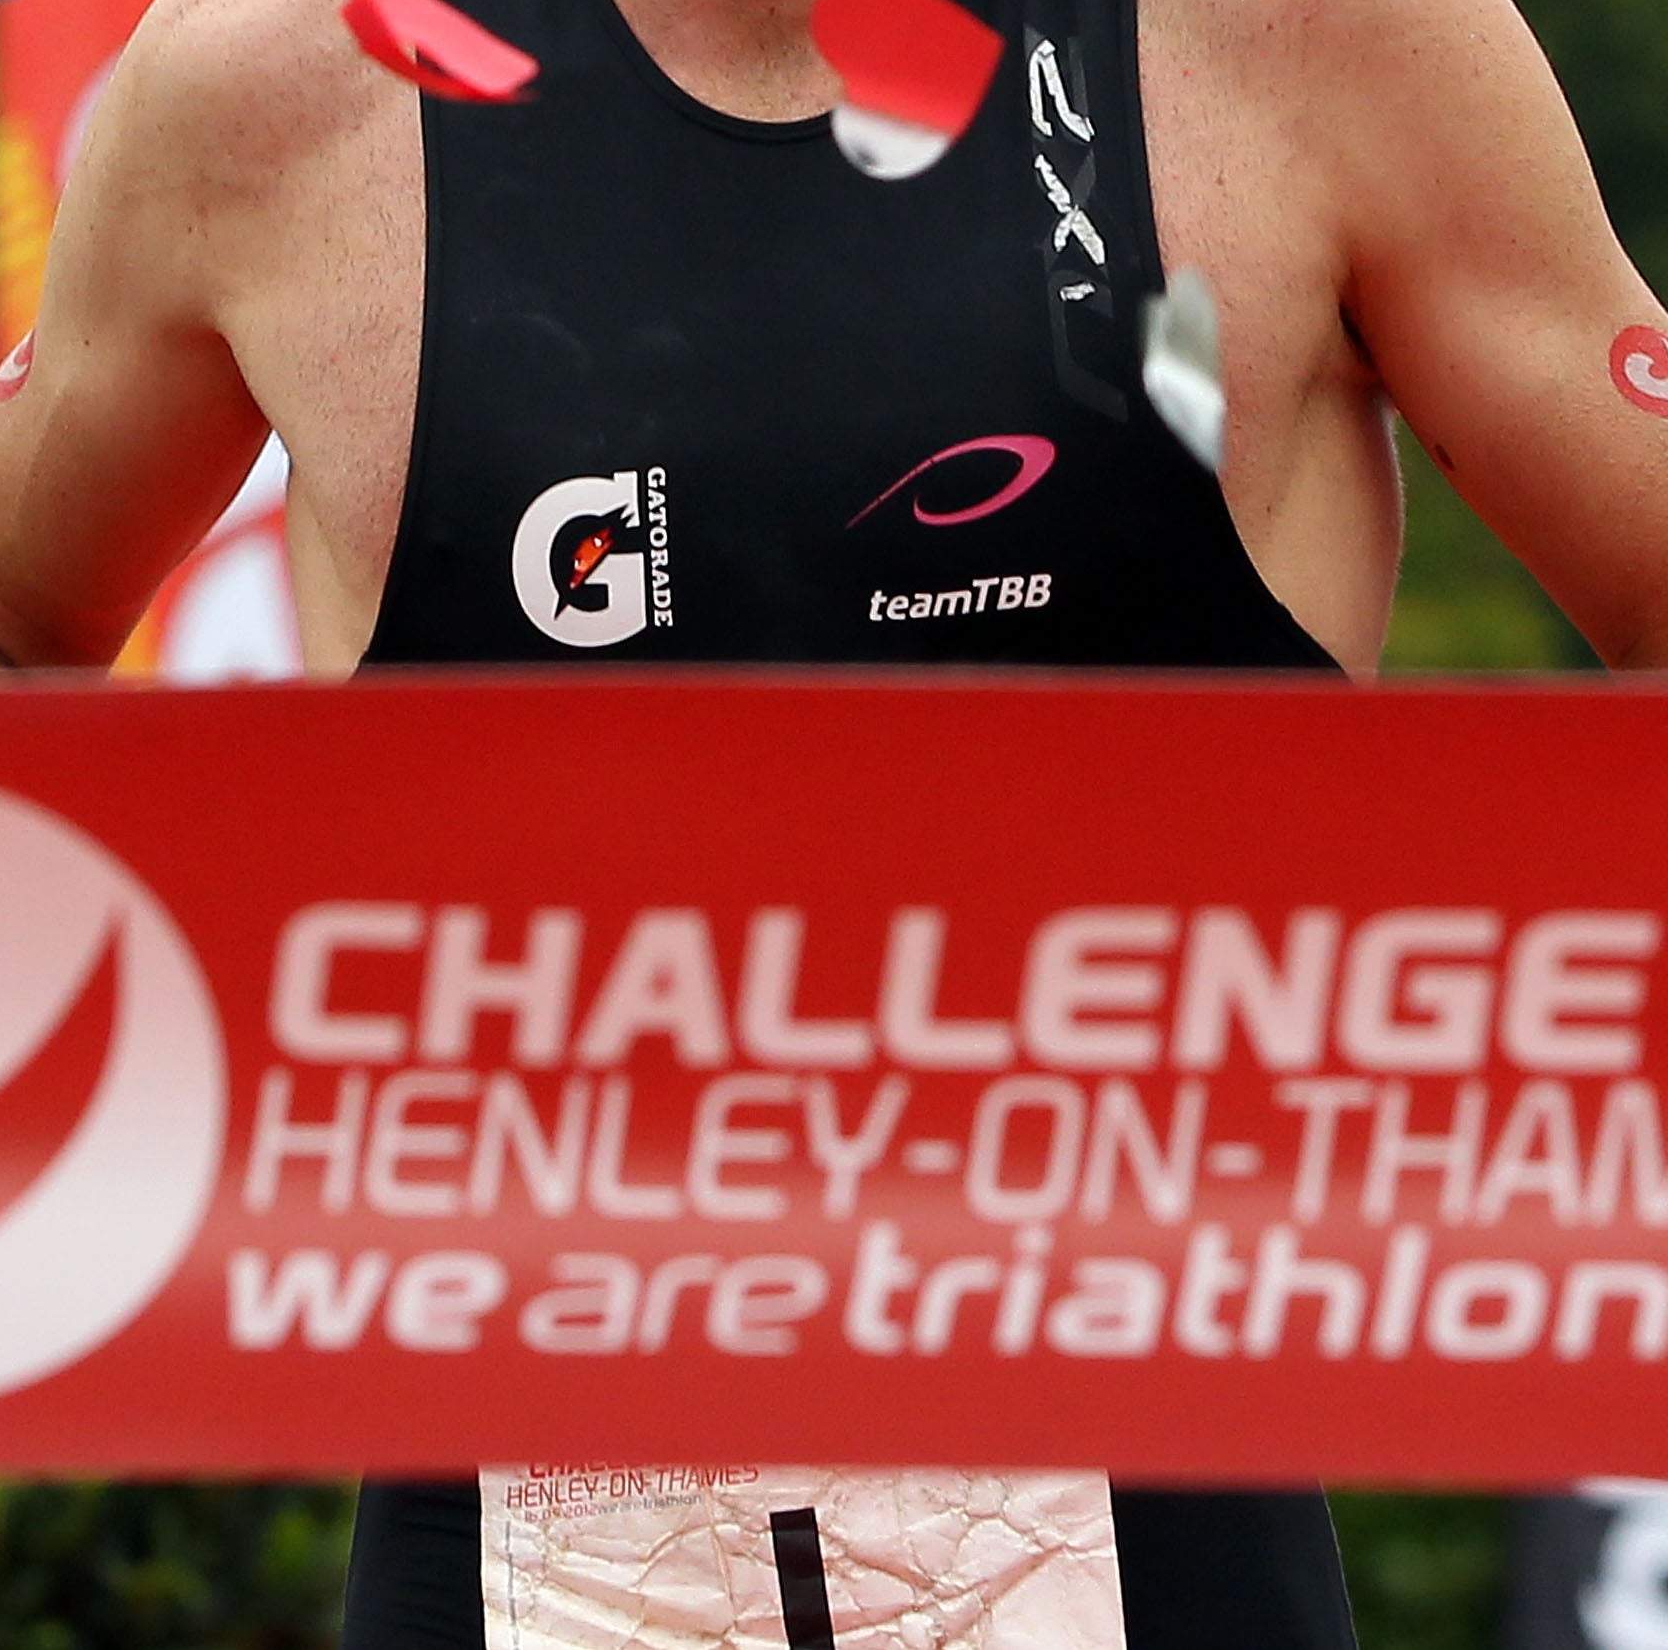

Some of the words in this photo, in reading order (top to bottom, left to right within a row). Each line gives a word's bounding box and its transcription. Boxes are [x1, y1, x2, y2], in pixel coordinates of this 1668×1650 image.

[647, 466, 674, 628] GATORADE
[868, 573, 1052, 622] teamTBB
[267, 897, 1662, 1072] CHALLENGE
[226, 1248, 510, 1353] we
[518, 1250, 829, 1358] are
